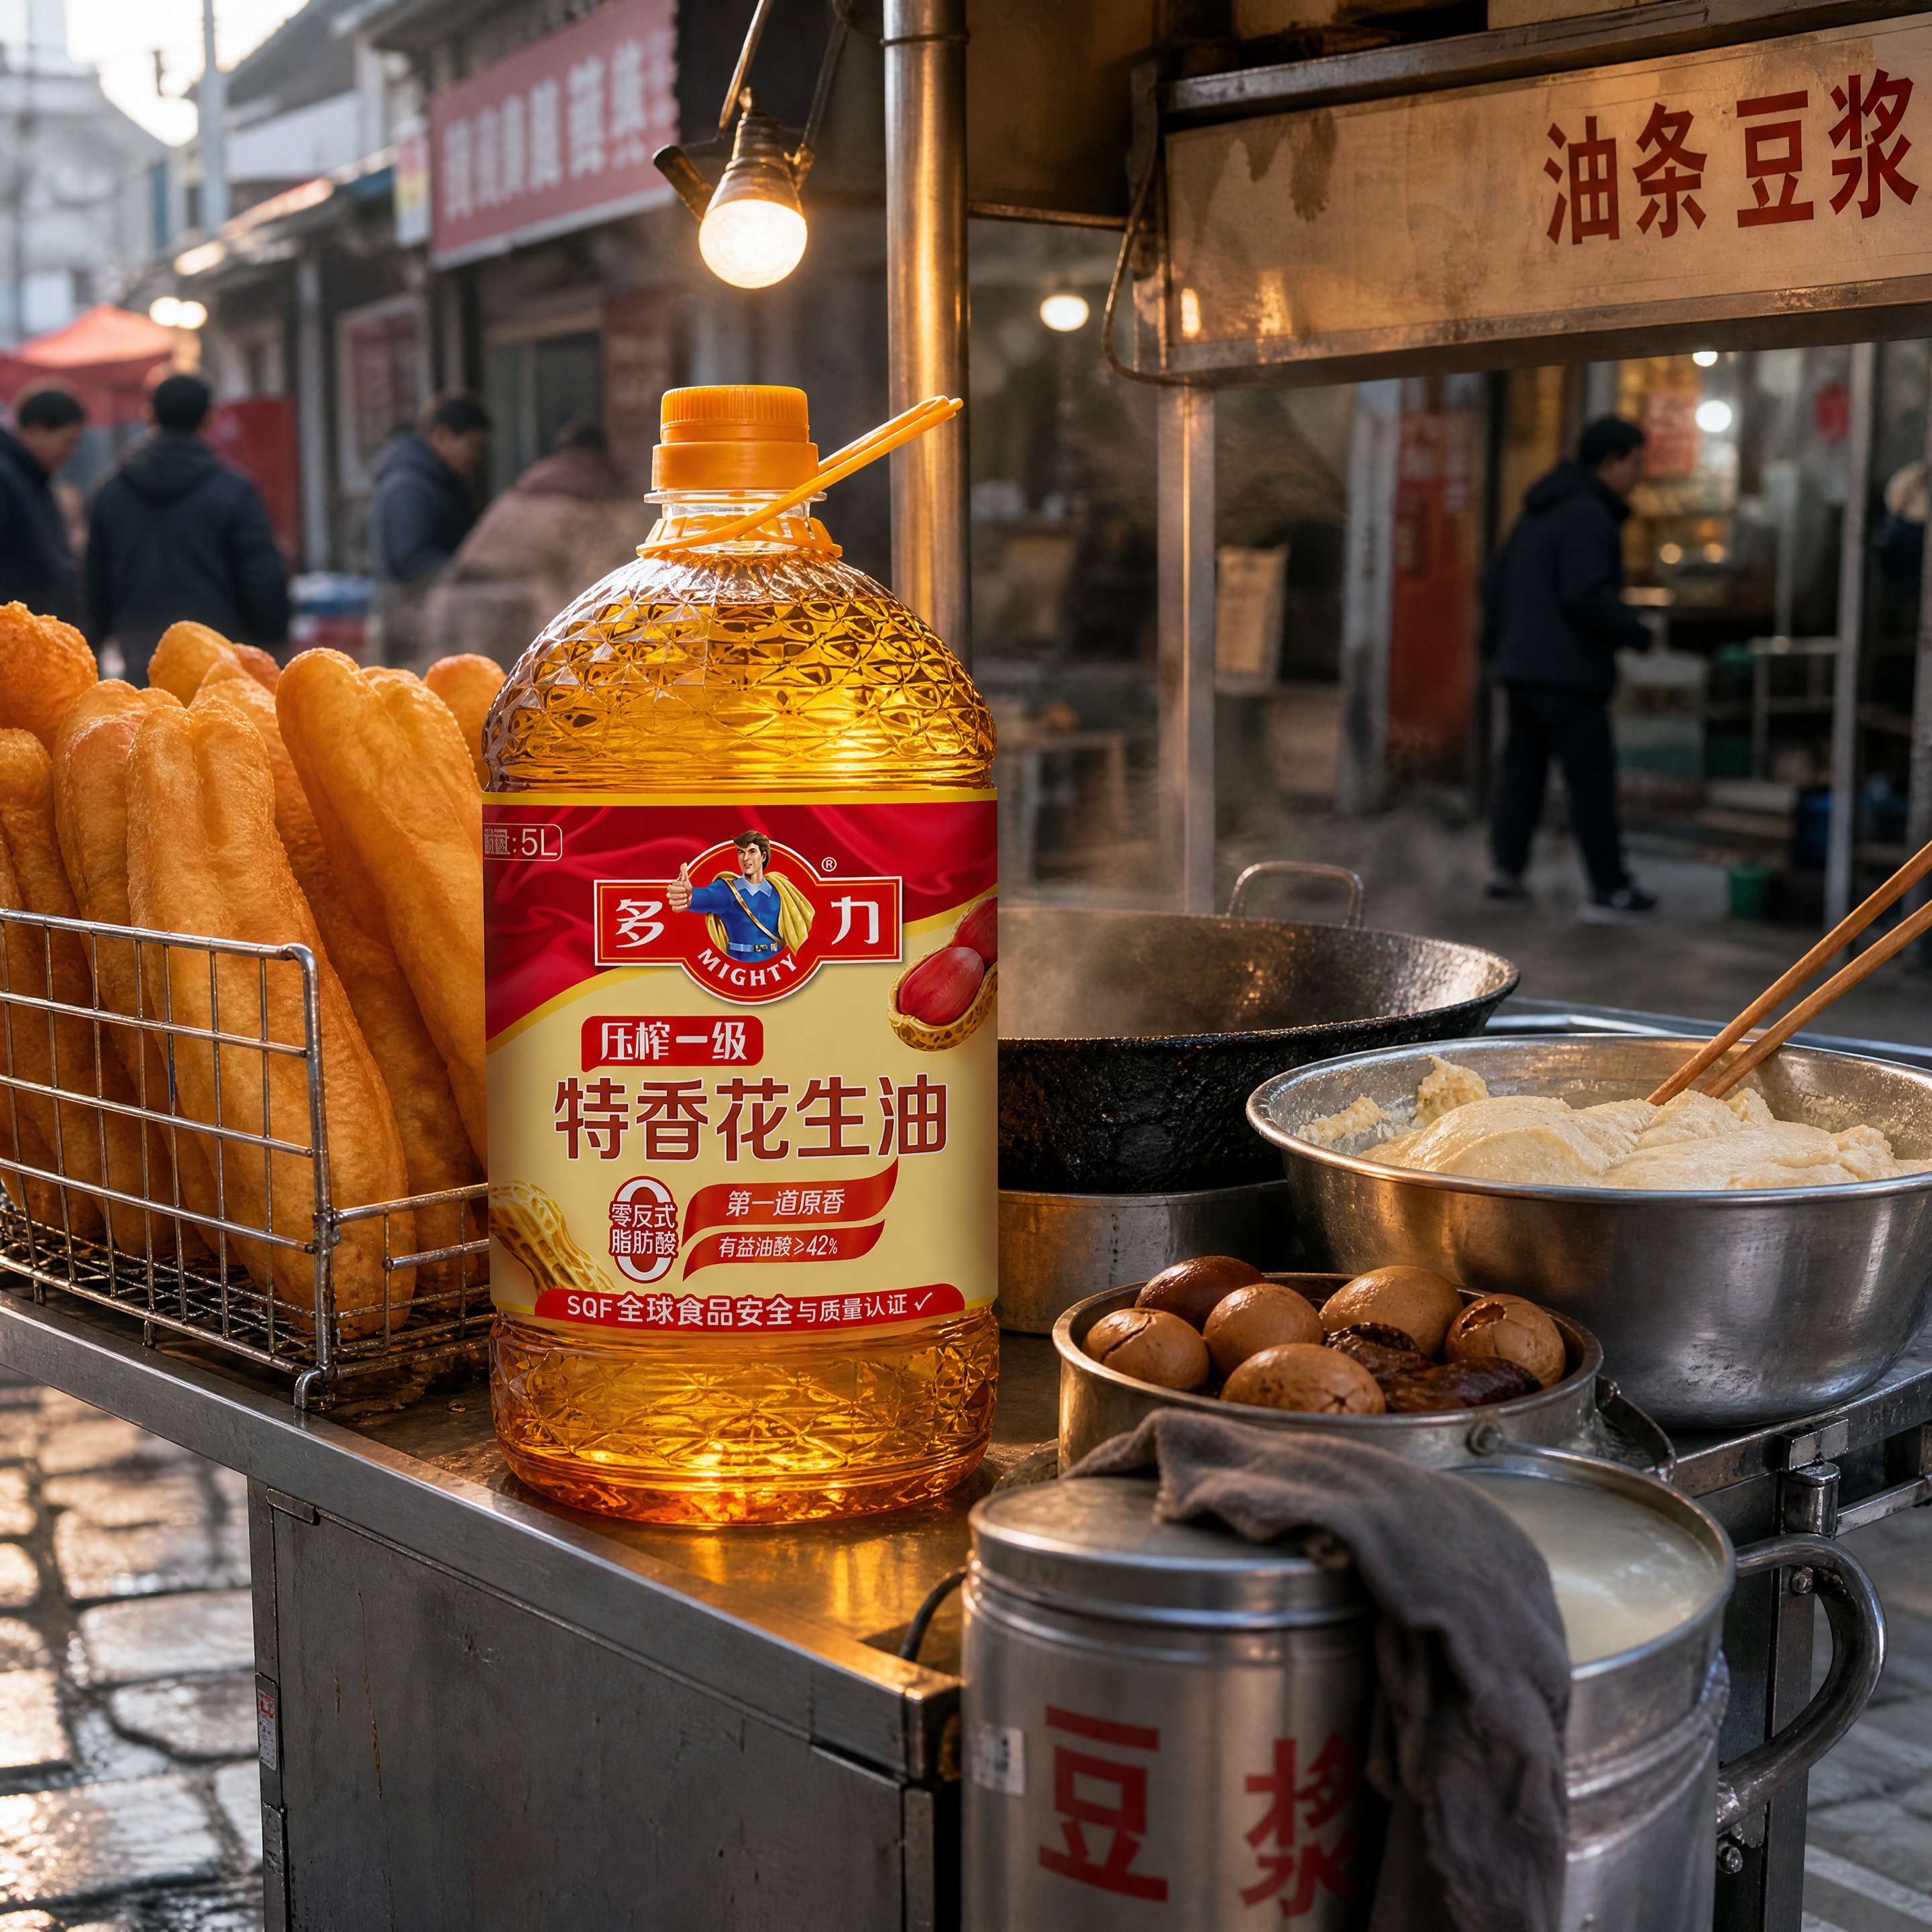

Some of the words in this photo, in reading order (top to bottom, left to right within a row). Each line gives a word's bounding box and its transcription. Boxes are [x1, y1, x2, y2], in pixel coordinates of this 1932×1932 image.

[1544, 68, 1919, 246] 油条豆浆
[697, 948, 797, 987] MIGHTY
[600, 1020, 748, 1061] 压榨一级
[554, 1073, 949, 1163] 特香花生油
[611, 1203, 676, 1228] 零反式
[725, 1188, 845, 1216] 第一道原香
[611, 1230, 676, 1256] 脂肪酸
